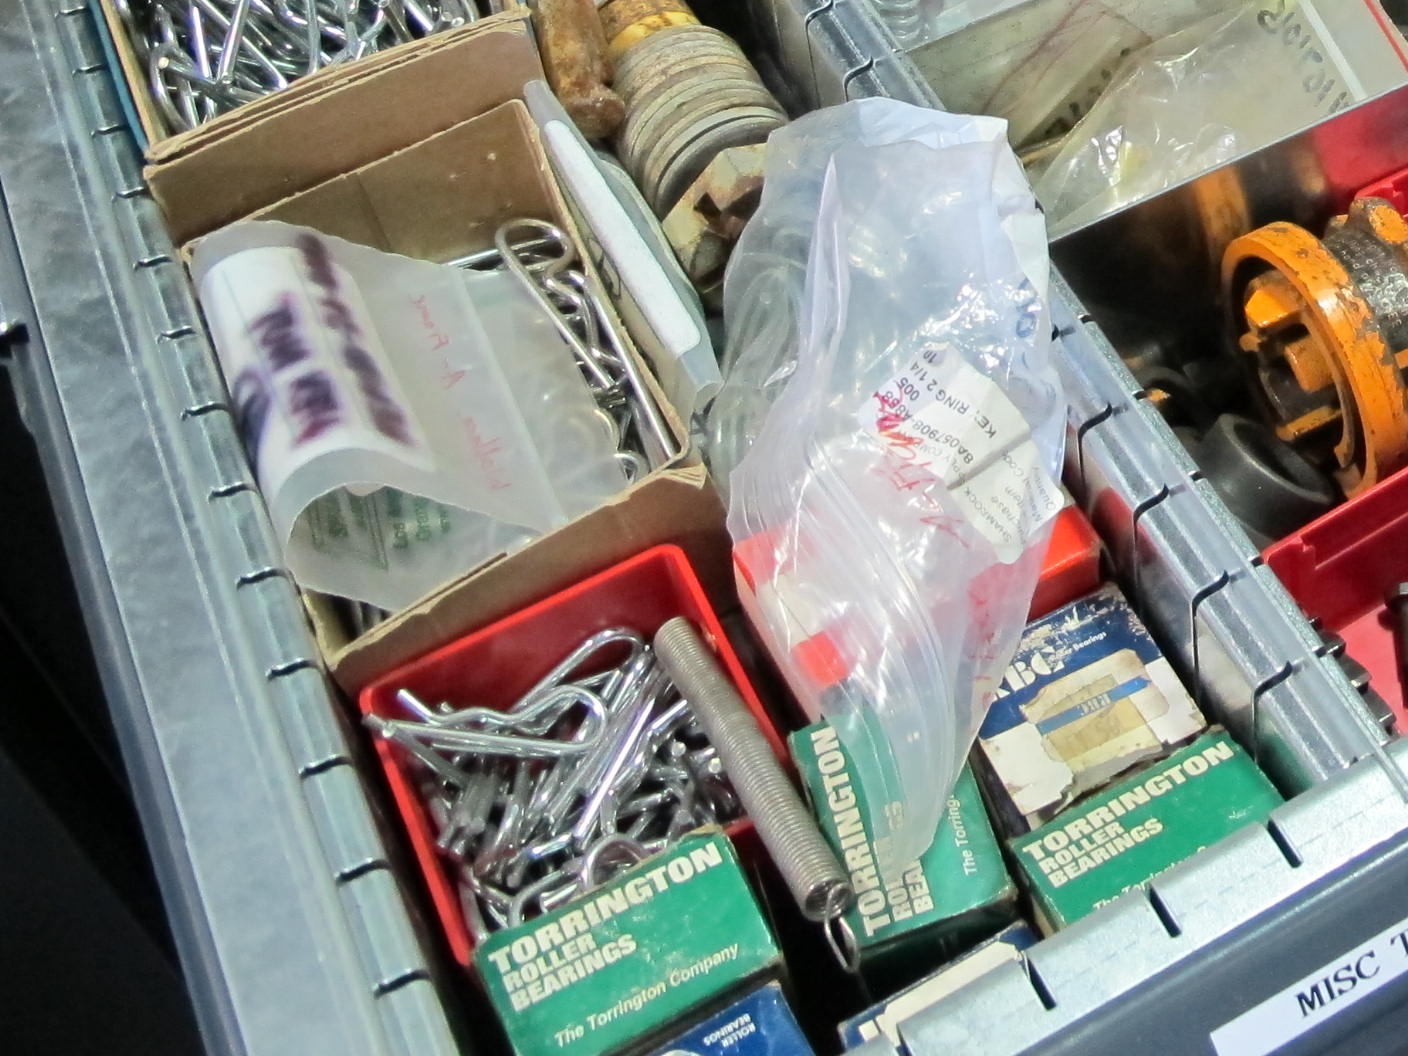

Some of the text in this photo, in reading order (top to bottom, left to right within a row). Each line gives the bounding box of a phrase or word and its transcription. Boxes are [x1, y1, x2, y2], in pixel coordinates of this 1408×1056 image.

[894, 374, 922, 402] 005
[907, 360, 929, 382] 1/4
[924, 377, 939, 392] 2
[934, 387, 970, 415] RING
[994, 646, 1065, 701] BC
[1022, 740, 1235, 862] TORRINGTON
[810, 726, 891, 936] TORRINGTON
[1038, 822, 1126, 875] ROLLER
[1048, 817, 1164, 888] BEARINGS
[962, 850, 977, 876] The
[488, 842, 723, 973] TORRINGTON
[502, 932, 598, 992] ROLLER
[508, 934, 637, 1013] BEARINGS
[1295, 949, 1381, 1018] MISC
[555, 943, 740, 1047] The Torrington Company
[703, 1013, 751, 1047] BEARINGS
[721, 1022, 756, 1048] ROLLER
